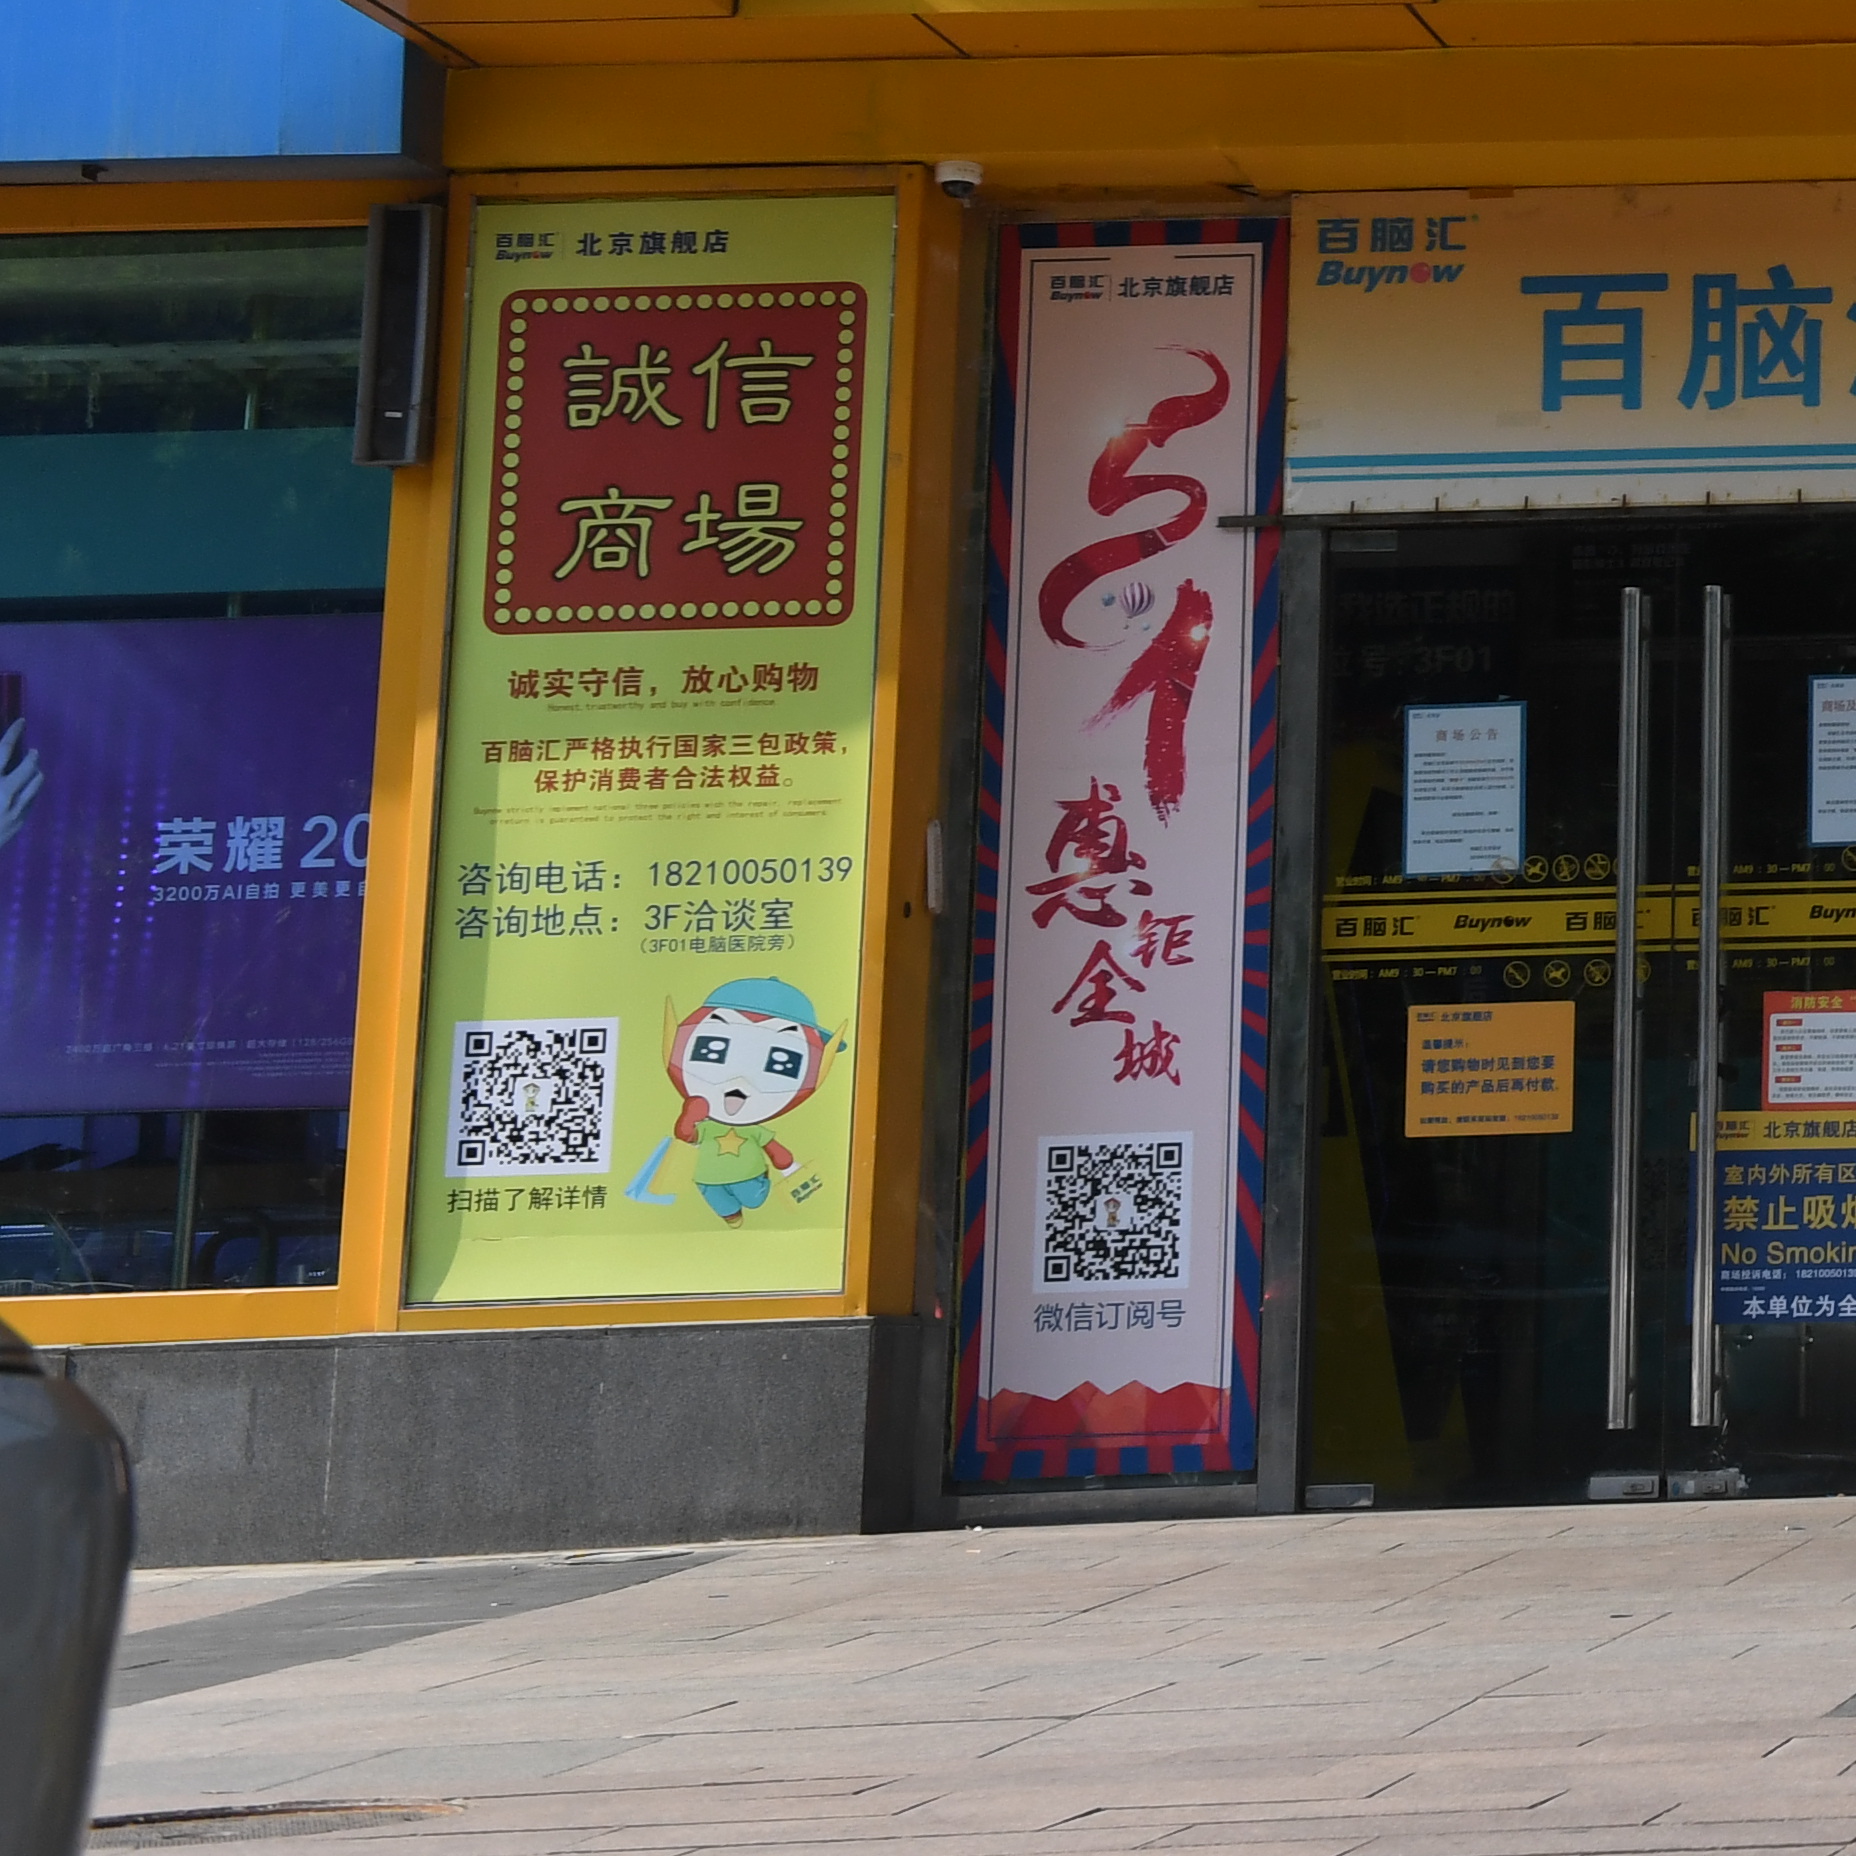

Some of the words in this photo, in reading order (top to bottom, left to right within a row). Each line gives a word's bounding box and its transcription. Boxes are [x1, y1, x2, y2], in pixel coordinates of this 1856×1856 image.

[495, 233, 556, 247] 百脑汇
[576, 229, 730, 257] 北京旗舰店
[1316, 216, 1467, 255] 百脑汇
[495, 249, 554, 262] Buynow
[1050, 275, 1106, 290] 百脑汇
[1118, 274, 1235, 298] 北京旗舰店
[1316, 258, 1465, 295] Buynow
[1050, 290, 1104, 303] Buynow
[562, 339, 813, 431] 誠信
[555, 483, 804, 580] 商場
[507, 662, 820, 700] 诚实守信，放心购物
[482, 731, 849, 764] 百脑汇严格执行国家三包政策，
[1435, 728, 1499, 742] 商场公告
[534, 764, 794, 795] 保护消费者合法权益。
[156, 816, 286, 875] 荣耀
[458, 860, 623, 896] 咨询电话：
[649, 856, 853, 887] 18210050139
[153, 883, 280, 902] 3200万AI自拍
[455, 903, 620, 939] 咨询地点：
[644, 898, 794, 933] 3F洽谈室
[1336, 917, 1415, 938] 百脑汇
[1454, 914, 1532, 932] Buynow
[1440, 1011, 1493, 1022] 北京旗舰店
[1421, 1055, 1555, 1074] 请您购物时见到您要
[447, 1185, 608, 1214] 扫描了解详情
[1721, 1242, 1757, 1266] No
[1033, 1300, 1186, 1334] 微信订阅号
